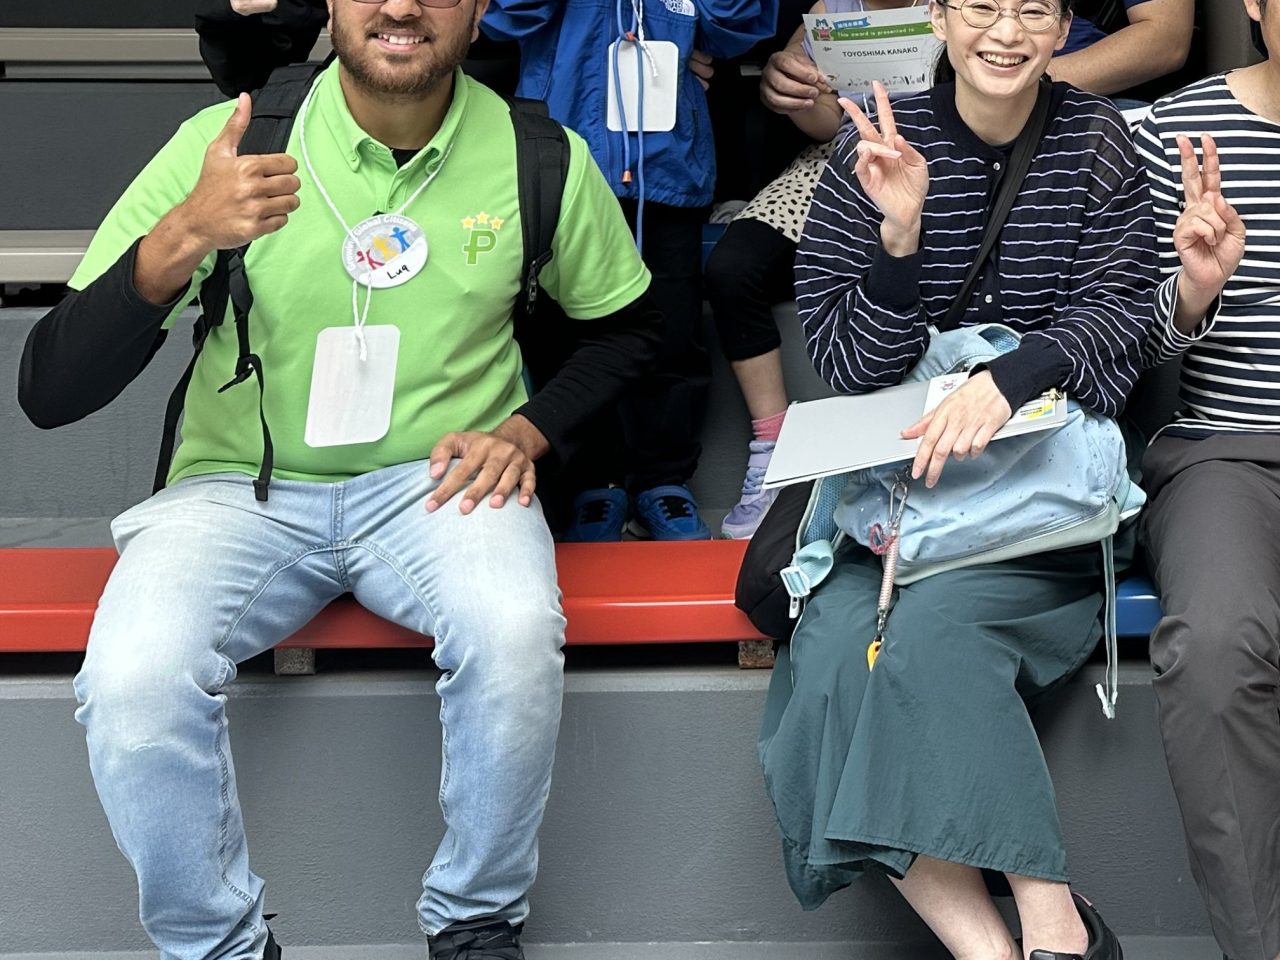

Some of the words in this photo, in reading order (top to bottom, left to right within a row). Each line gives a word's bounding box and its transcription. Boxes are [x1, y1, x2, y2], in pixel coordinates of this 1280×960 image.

[877, 28, 906, 37] presented
[842, 48, 886, 58] TOYOSHIMA
[887, 46, 918, 55] KANAKO
